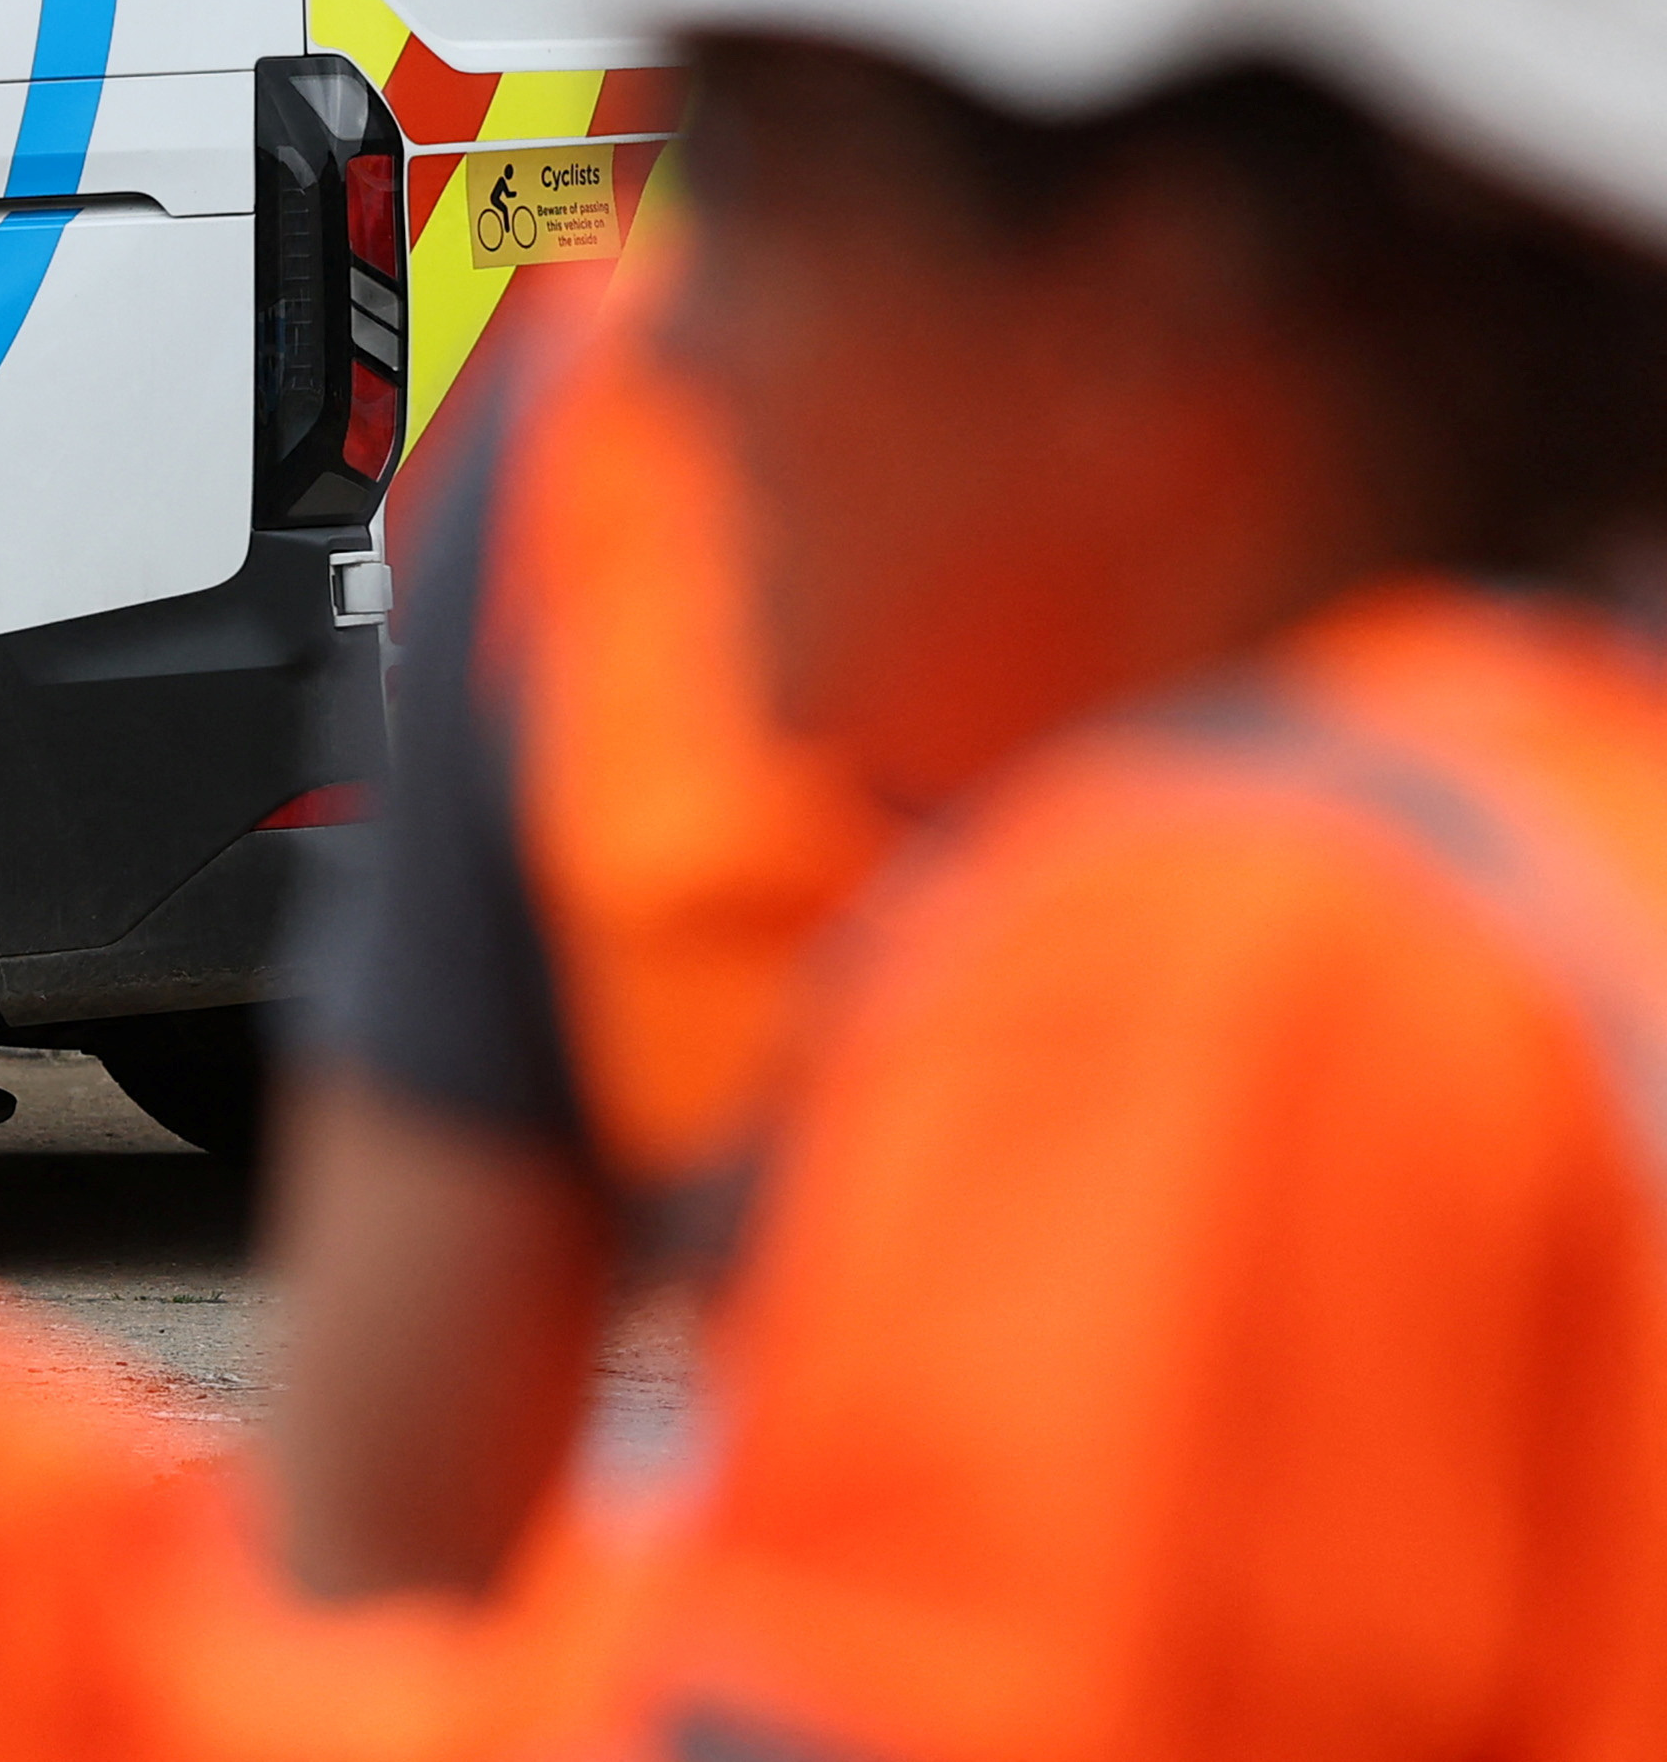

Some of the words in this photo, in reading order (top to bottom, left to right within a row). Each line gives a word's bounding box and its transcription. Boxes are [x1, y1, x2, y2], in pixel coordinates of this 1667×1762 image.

[541, 163, 601, 192] Cyclists
[537, 204, 568, 217] Beware
[569, 201, 578, 215] of
[579, 200, 610, 216] passing
[546, 219, 563, 232] this
[564, 218, 593, 231] vehicle
[593, 218, 605, 229] on
[558, 235, 572, 247] the
[574, 233, 598, 246] inside
